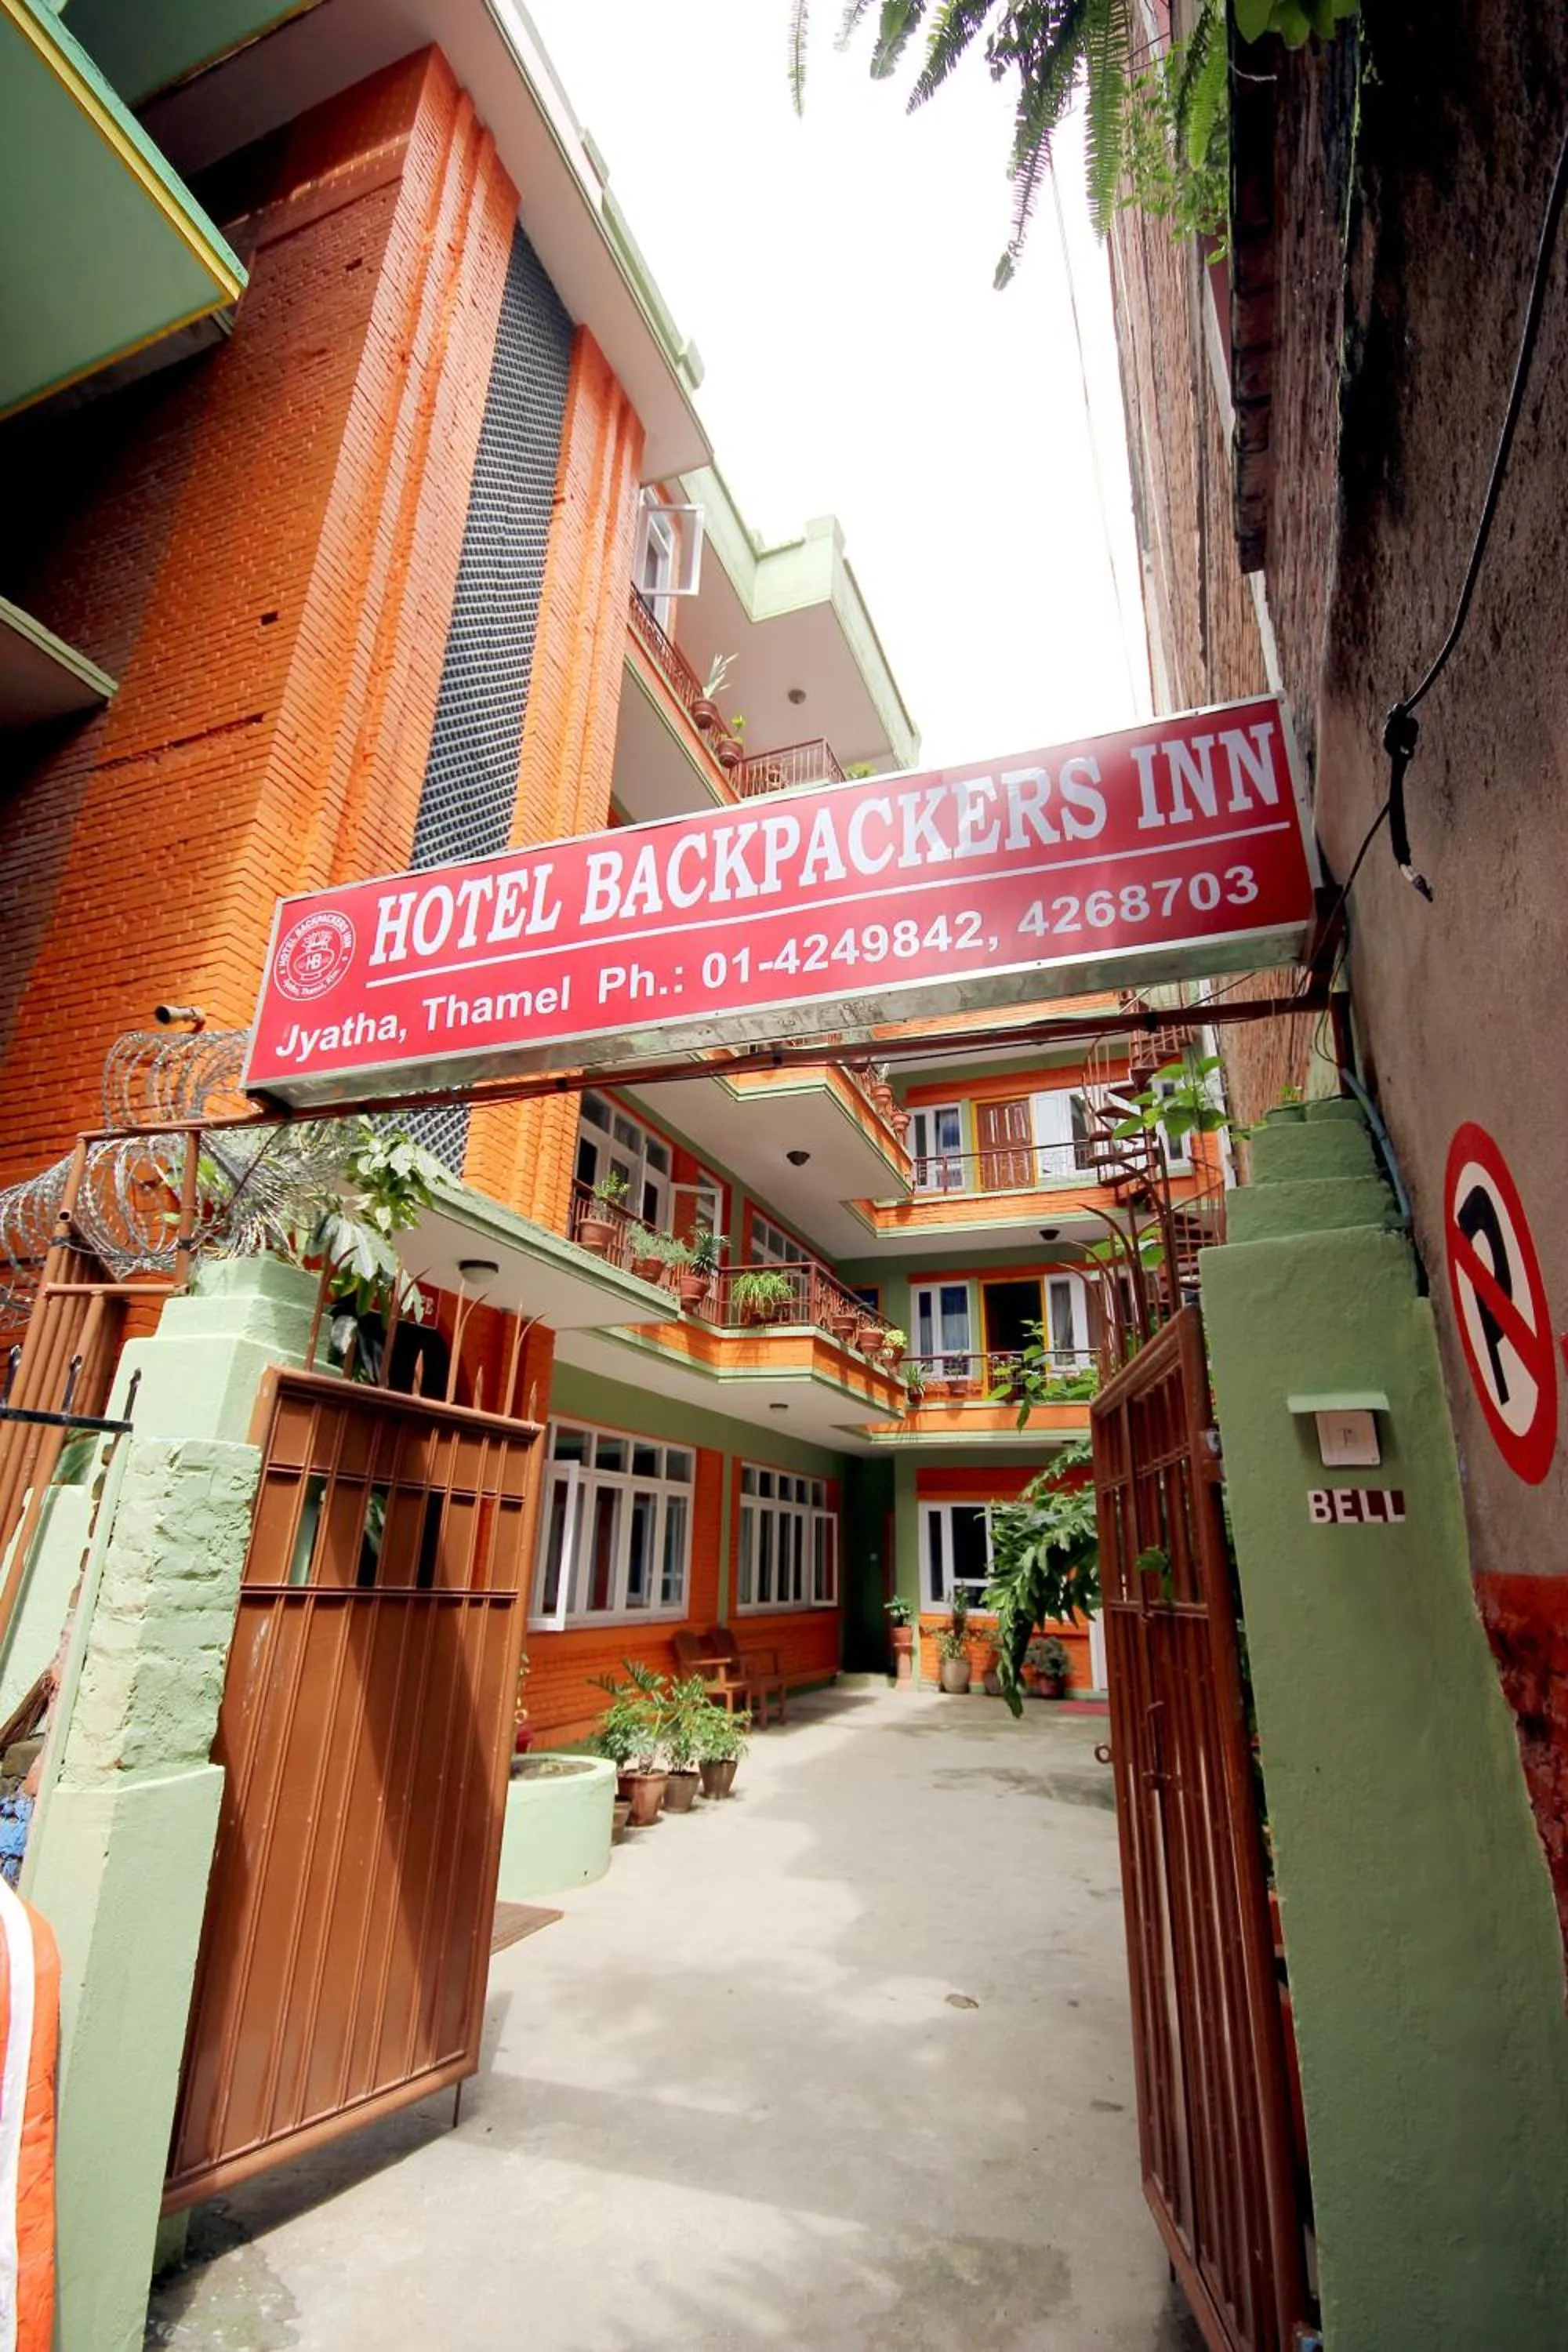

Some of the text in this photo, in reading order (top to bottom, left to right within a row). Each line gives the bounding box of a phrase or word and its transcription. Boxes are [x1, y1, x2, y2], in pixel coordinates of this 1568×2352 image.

[368, 721, 1280, 967] HOTEL BACKPACKERS INN
[274, 865, 1260, 1063] Jyatha, Thamel Ph.: 01-4249842, 4268703
[1307, 1489, 1406, 1523] BELL
